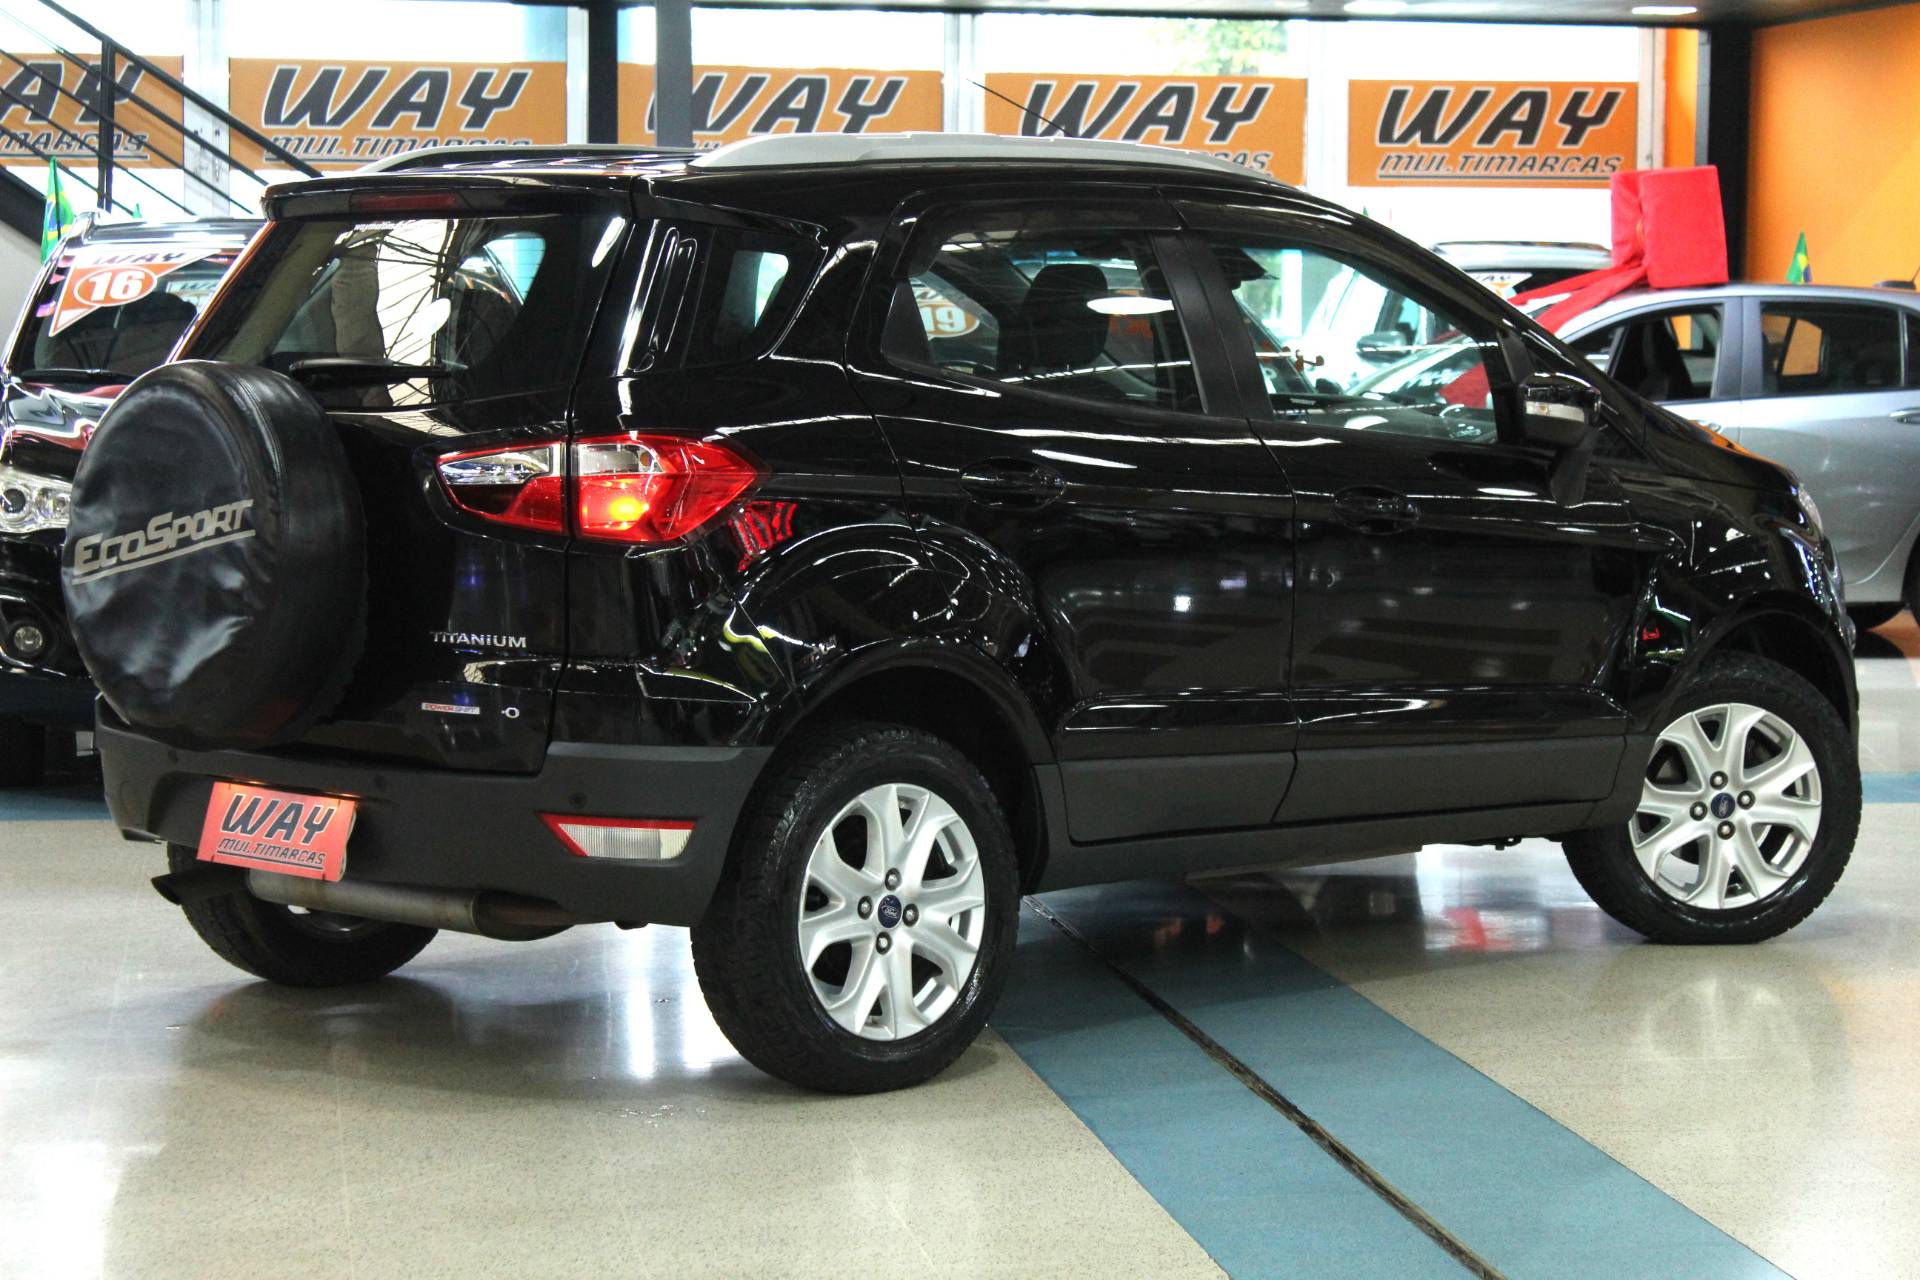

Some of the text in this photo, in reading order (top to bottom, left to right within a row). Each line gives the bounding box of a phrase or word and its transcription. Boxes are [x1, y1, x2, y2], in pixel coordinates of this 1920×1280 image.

[0, 60, 145, 125] AY
[261, 65, 533, 131] WAY
[645, 73, 908, 134] WAY
[1019, 81, 1274, 144] WAY
[1376, 86, 1625, 149] WAY
[1378, 153, 1624, 174] MULTIMARCAS
[88, 270, 146, 302] 16
[919, 305, 967, 333] 19
[220, 793, 337, 846] WAY
[217, 837, 327, 866] MULTIMARCAS
